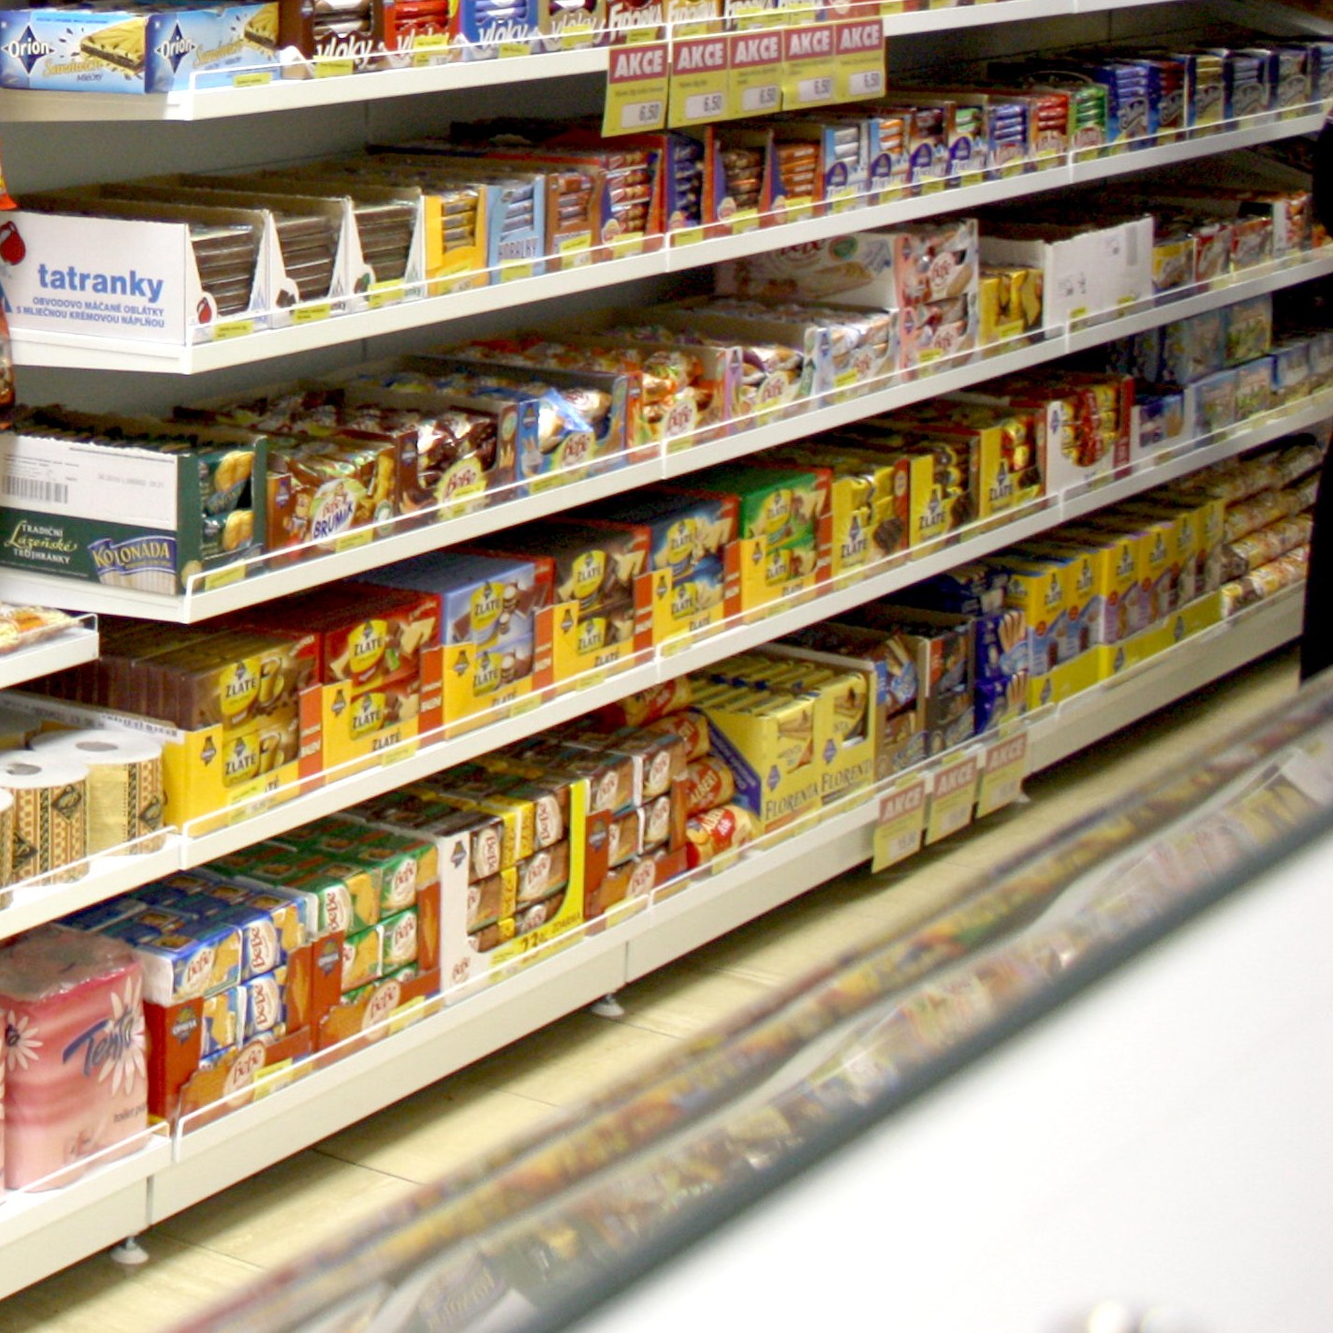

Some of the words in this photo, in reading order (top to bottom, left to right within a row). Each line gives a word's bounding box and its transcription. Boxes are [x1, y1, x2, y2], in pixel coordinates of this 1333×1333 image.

[7, 37, 51, 59] Orion
[158, 36, 195, 56] Orion
[789, 30, 830, 55] AKCE
[840, 23, 880, 49] AKCE
[614, 49, 664, 79] AKCE
[677, 42, 724, 70] AKCE
[735, 38, 779, 64] AKCE
[38, 263, 164, 304] tatranky
[92, 540, 172, 568] KOLONÁDA
[62, 1011, 137, 1077] Tento
